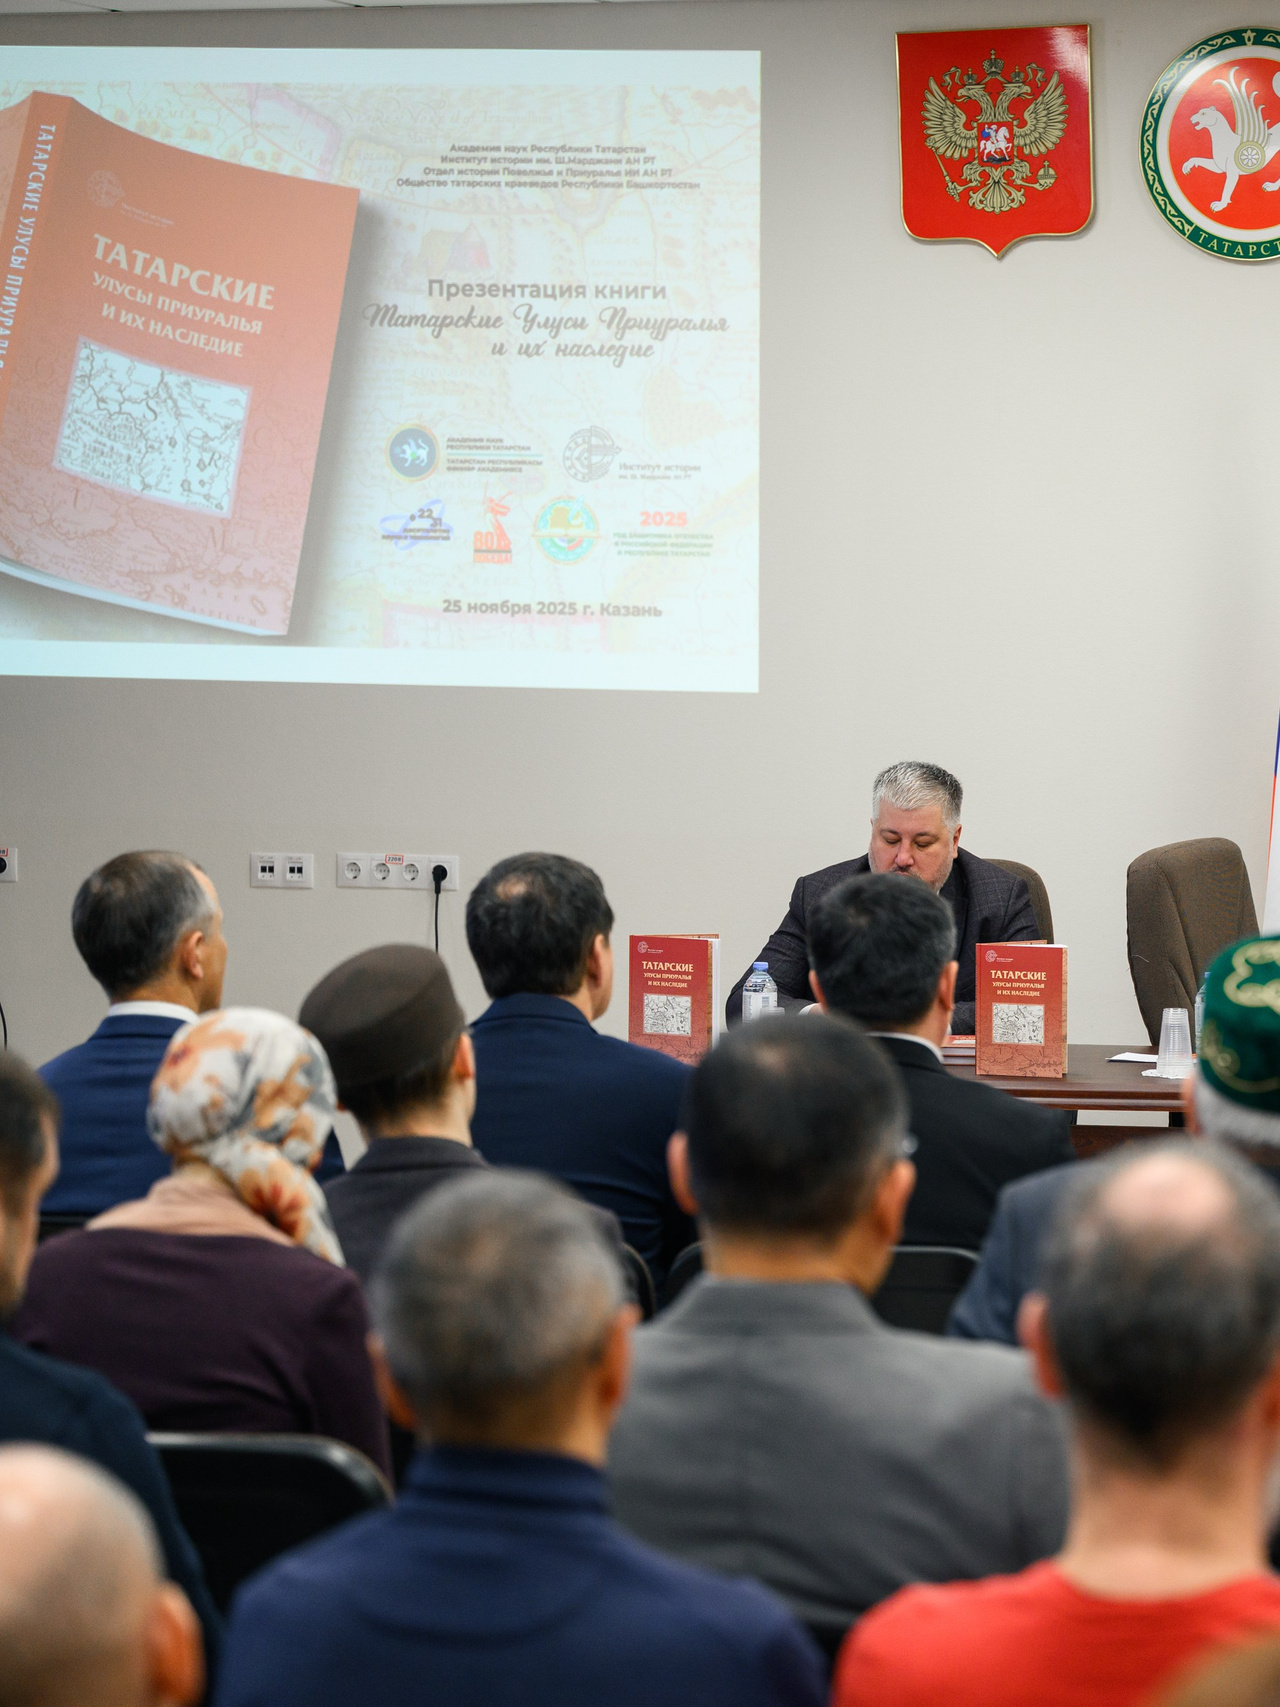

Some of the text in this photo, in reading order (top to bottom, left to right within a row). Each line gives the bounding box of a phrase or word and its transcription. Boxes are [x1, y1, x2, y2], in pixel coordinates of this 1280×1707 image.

[450, 144, 646, 155] Академия наук Республики Татарстан
[22, 124, 56, 212] ТАТАРСКИЕ
[441, 155, 488, 165] Институт
[490, 157, 533, 165] истории
[643, 157, 656, 165] РТ
[424, 167, 454, 176] Отдел
[457, 169, 499, 177] истории
[502, 168, 553, 177] Поволжья
[566, 168, 621, 178] Приуралья
[625, 169, 639, 177] ИИ
[642, 169, 657, 177] АН
[660, 169, 673, 178] РТ
[397, 178, 700, 190] Общество татарских краеведов Республики Башкортостан
[10, 216, 36, 269] УЛУСЫ
[93, 233, 274, 310] ТАТАРСКИЕ
[428, 279, 666, 301] Презентация книги
[93, 271, 263, 335] УЛУСЫ ПРИУРАЛЬЯ
[102, 303, 243, 357] И ИХ НАСЛЕДИЕ
[363, 303, 504, 339] Татарские
[491, 340, 655, 368] и их наследие
[619, 463, 662, 473] Институт
[418, 508, 433, 519] 22
[640, 511, 687, 527] 2025
[473, 531, 493, 550] 80
[442, 599, 663, 617] 25 ноября 2025 г. Казань
[642, 961, 694, 972] ТАТАРСКИЕ
[990, 970, 1047, 980] ТАТАРСКИЕ
